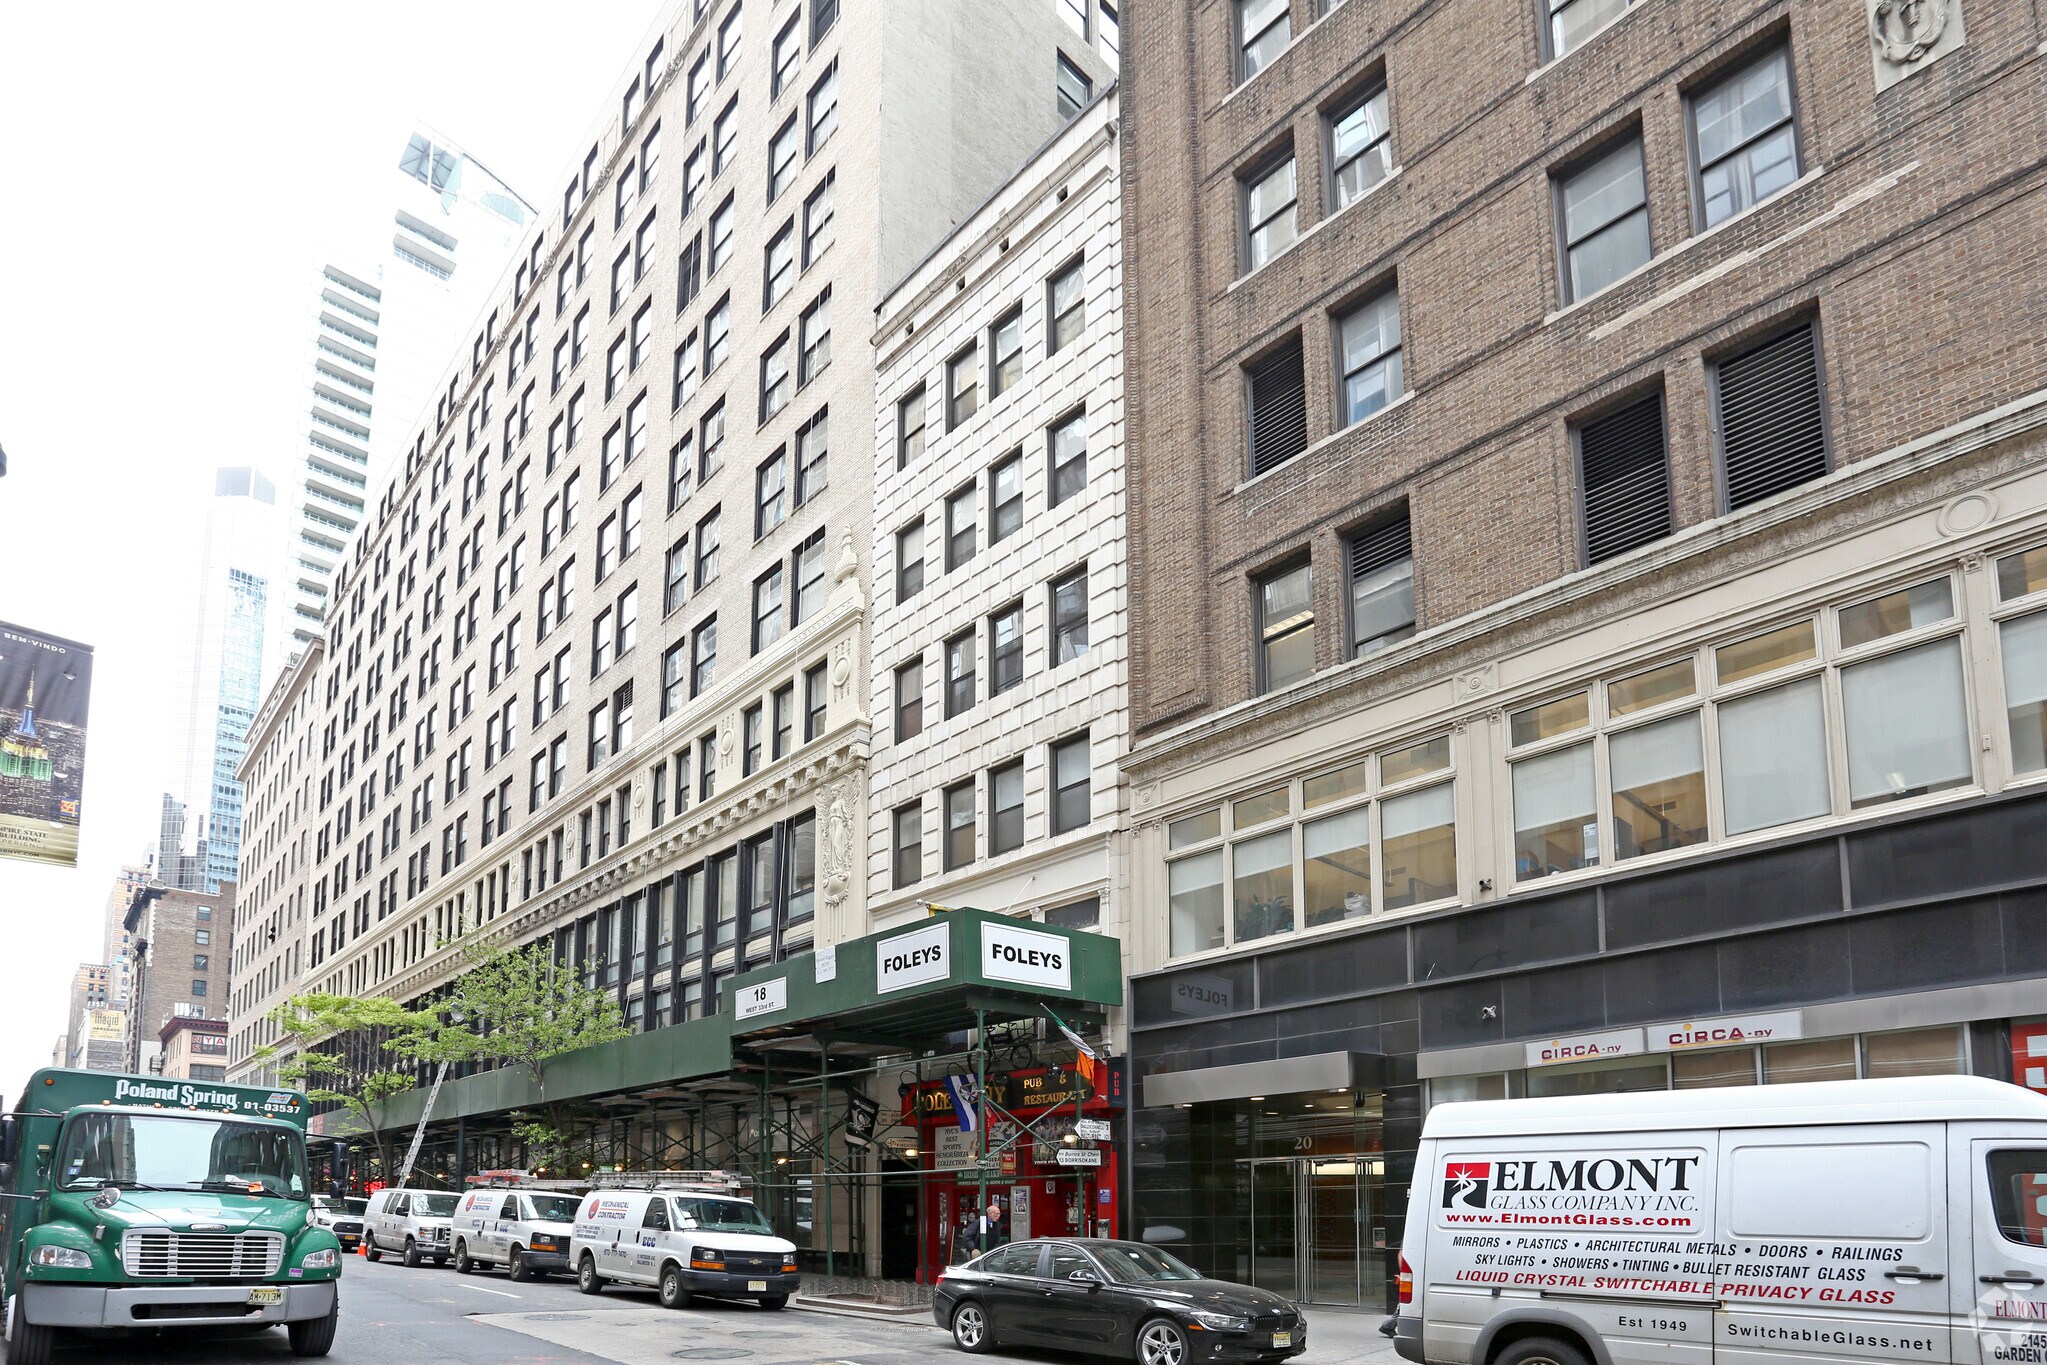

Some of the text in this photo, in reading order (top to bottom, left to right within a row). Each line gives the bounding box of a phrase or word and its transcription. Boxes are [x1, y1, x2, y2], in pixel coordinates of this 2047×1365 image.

[4, 632, 66, 653] BEM-VINDO
[24, 830, 48, 838] STATE
[884, 944, 942, 974] FOLEYS
[992, 943, 1062, 970] FOLEYS
[754, 987, 766, 1002] 18
[746, 1005, 758, 1014] WEST
[758, 1003, 768, 1011] 33rd
[1024, 1071, 1067, 1089] PUB &
[115, 1079, 238, 1110] Poland Spring
[1024, 1089, 1087, 1106] RESTAURT
[244, 1101, 301, 1114] 01-03537
[1294, 1136, 1312, 1150] 20
[1492, 1155, 1699, 1192] ELMONT
[601, 1201, 630, 1209] MECHANICAL
[1490, 1195, 1698, 1211] GLASS COMPANY INC.
[598, 1212, 626, 1220] CONTRACTOR
[1446, 1213, 1691, 1226] www.ElmontGlass.com
[642, 1237, 656, 1247] ECC
[1452, 1236, 1903, 1262] MIRRORS PLASTICS ARCHITECTURAL METALS DOORS RAILINGS
[1475, 1254, 1866, 1282] SKY LIGHTS SHOWERS TINTING BULLET RESISTANT GLASS
[1456, 1270, 1896, 1304] LIQUID CRYSTAL SWITCHABLE PRIVACY GLASS
[1996, 1300, 2047, 1319] ELMONT
[1618, 1316, 1688, 1331] Est 1949
[1728, 1323, 1933, 1351] SwitchableGlass.net
[2021, 1334, 2047, 1348] 2145
[1994, 1346, 2041, 1363] GARDEN
